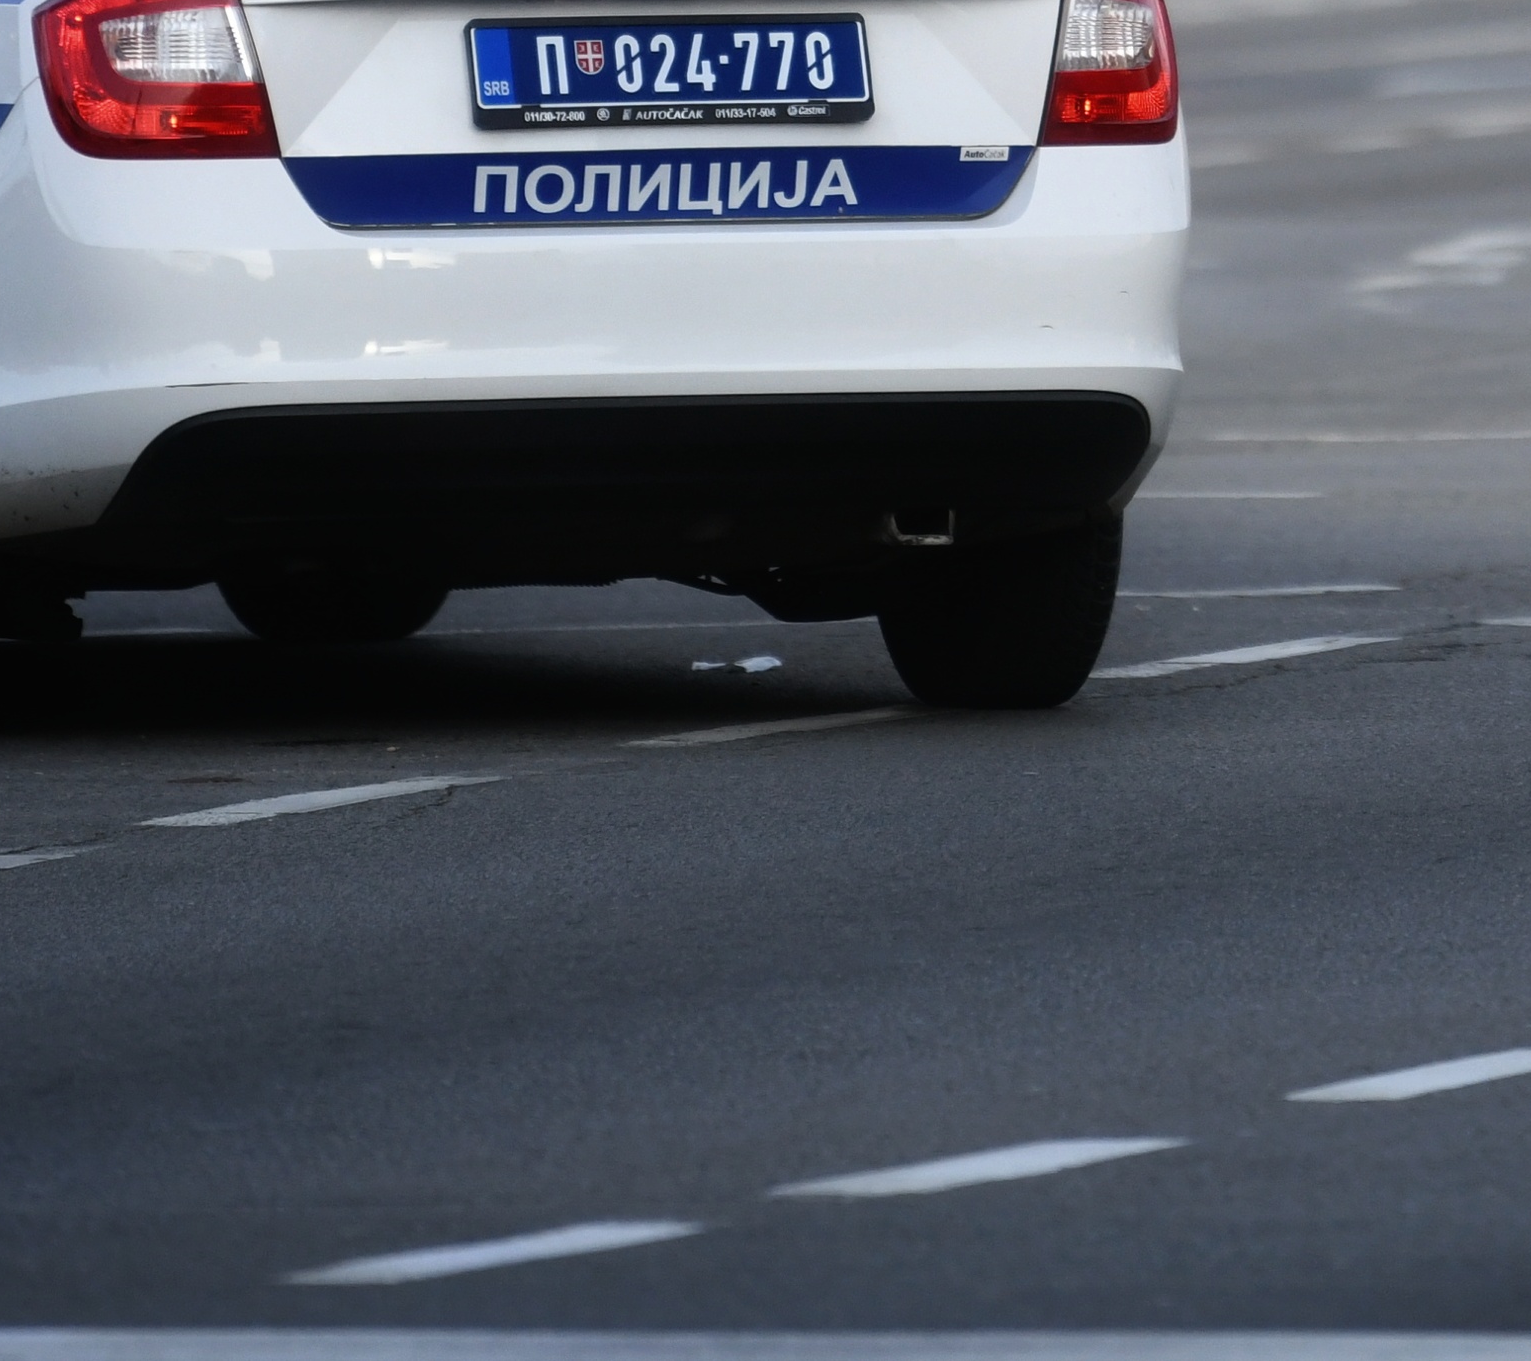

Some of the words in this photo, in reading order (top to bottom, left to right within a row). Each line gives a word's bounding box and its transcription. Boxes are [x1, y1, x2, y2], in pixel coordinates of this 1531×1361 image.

[536, 35, 570, 95] П
[483, 81, 511, 97] SRB
[635, 108, 704, 121] AUTOČAČAK
[798, 106, 827, 115] Castrol
[473, 158, 858, 215] ПОЛИЦИЈА
